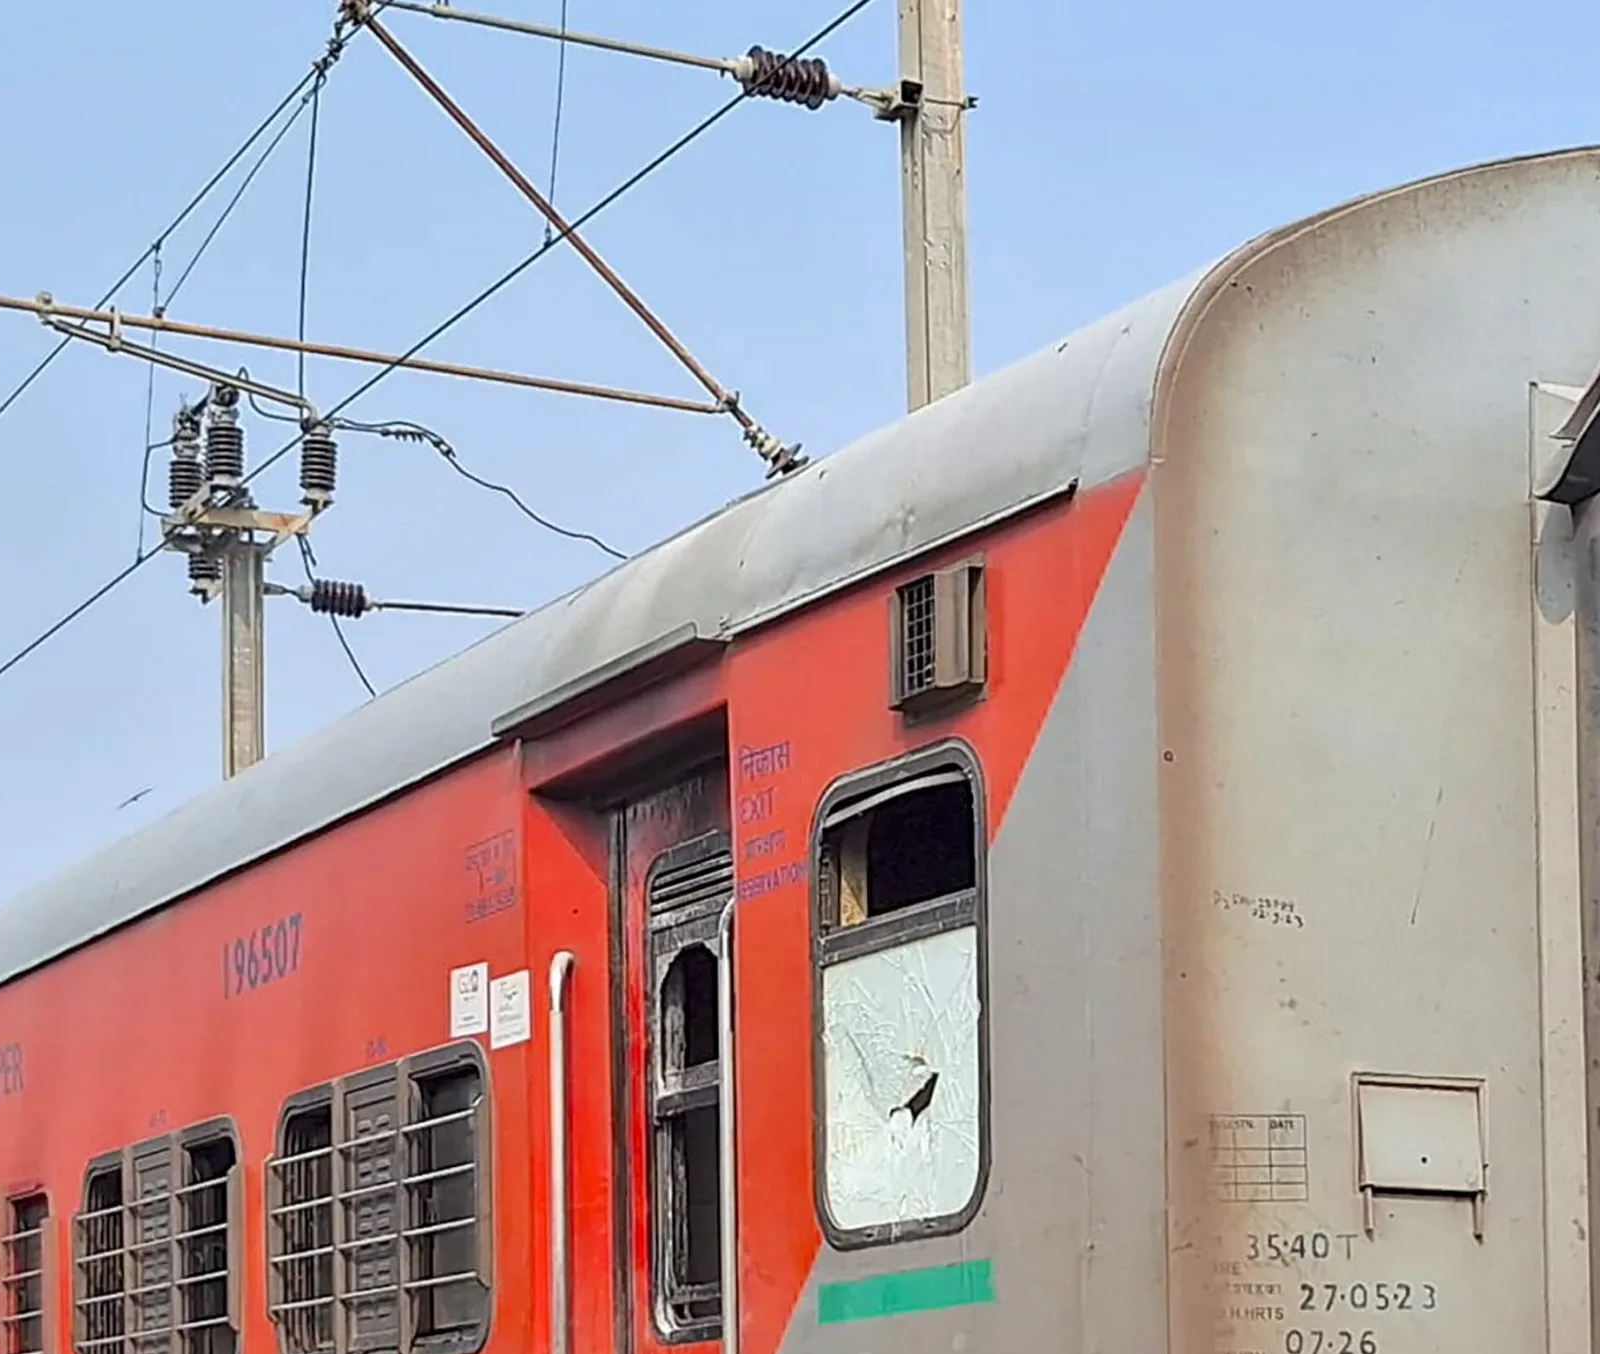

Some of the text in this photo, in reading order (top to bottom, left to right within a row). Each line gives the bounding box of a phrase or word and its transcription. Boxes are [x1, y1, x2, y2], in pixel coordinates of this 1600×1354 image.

[739, 742, 791, 781] निकास
[741, 788, 776, 824] EXIT
[222, 914, 302, 999] 196507
